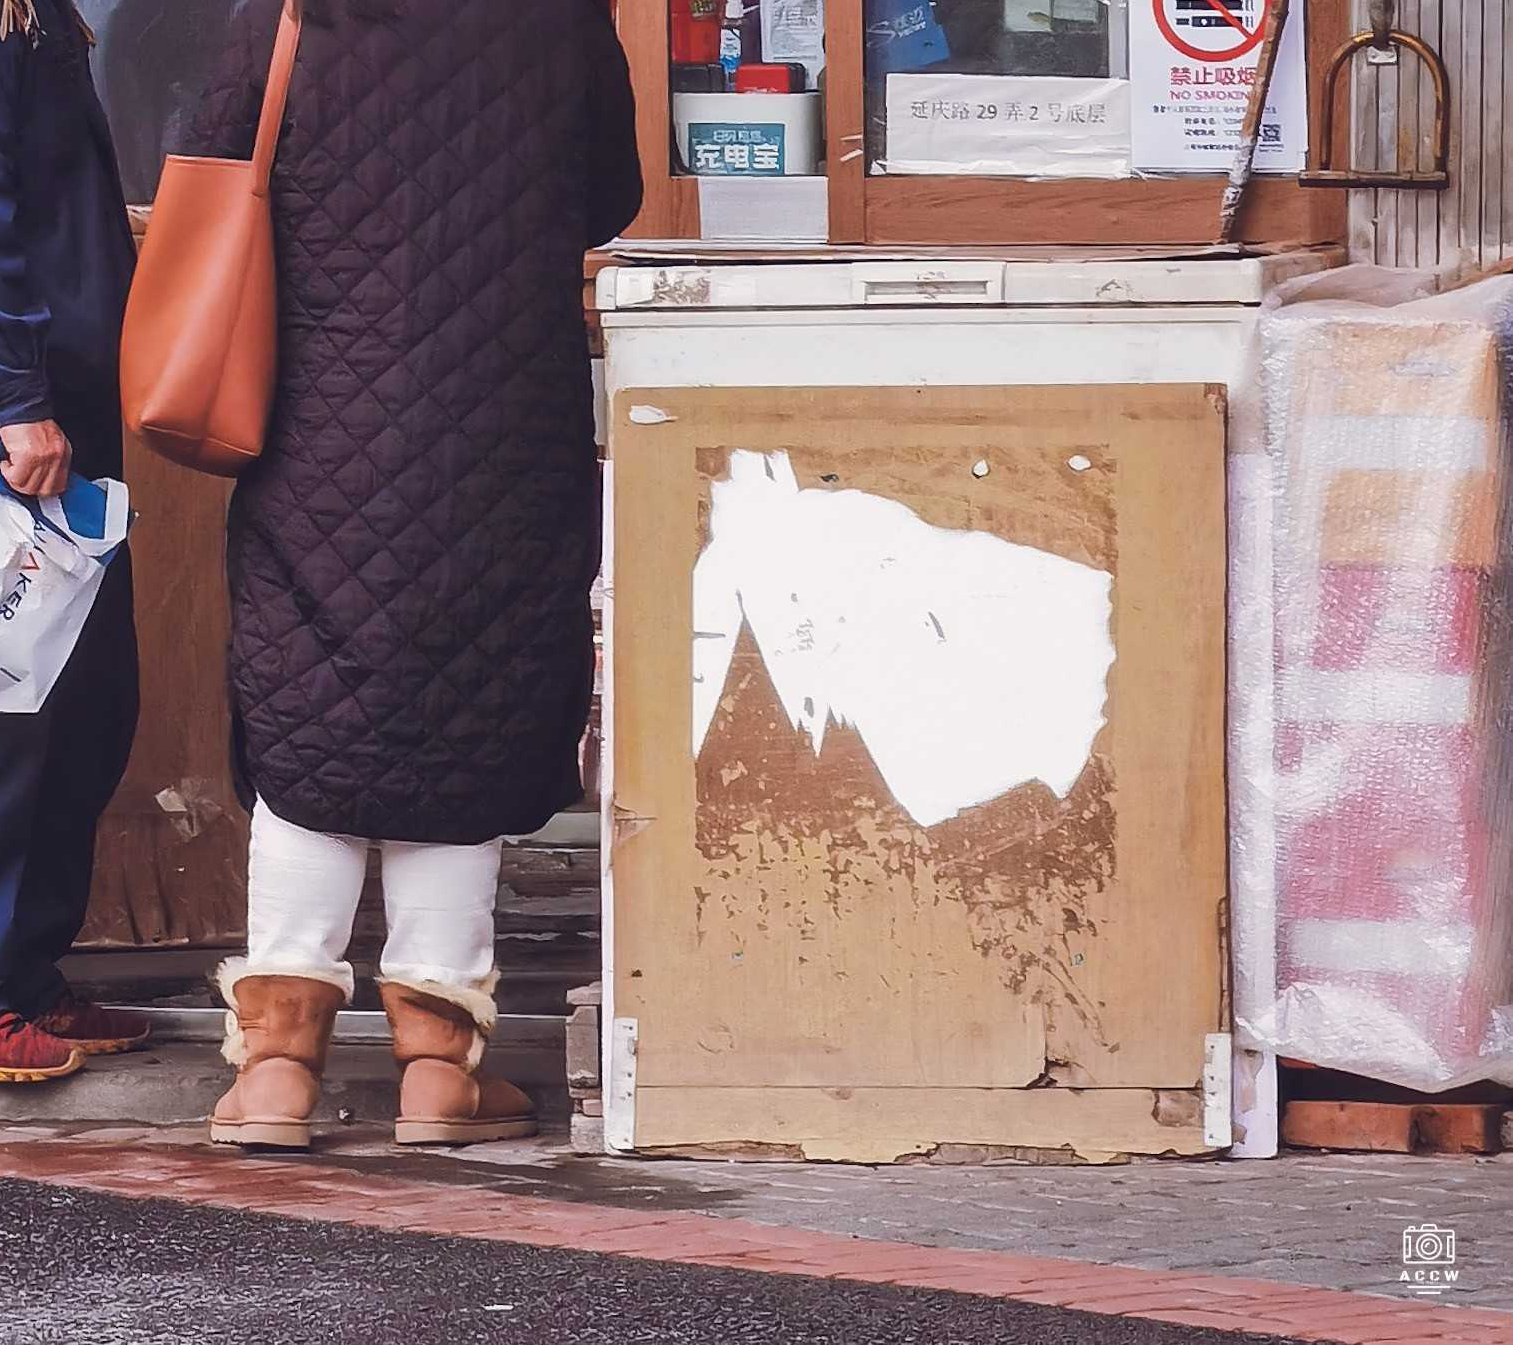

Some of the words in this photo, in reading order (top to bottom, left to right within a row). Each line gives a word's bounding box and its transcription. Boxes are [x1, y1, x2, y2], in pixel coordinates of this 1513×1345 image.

[1170, 66, 1257, 86] 禁止吸烟
[1170, 90, 1192, 101] NO
[1195, 90, 1250, 101] SMOKIN
[695, 143, 780, 170] 充电宝
